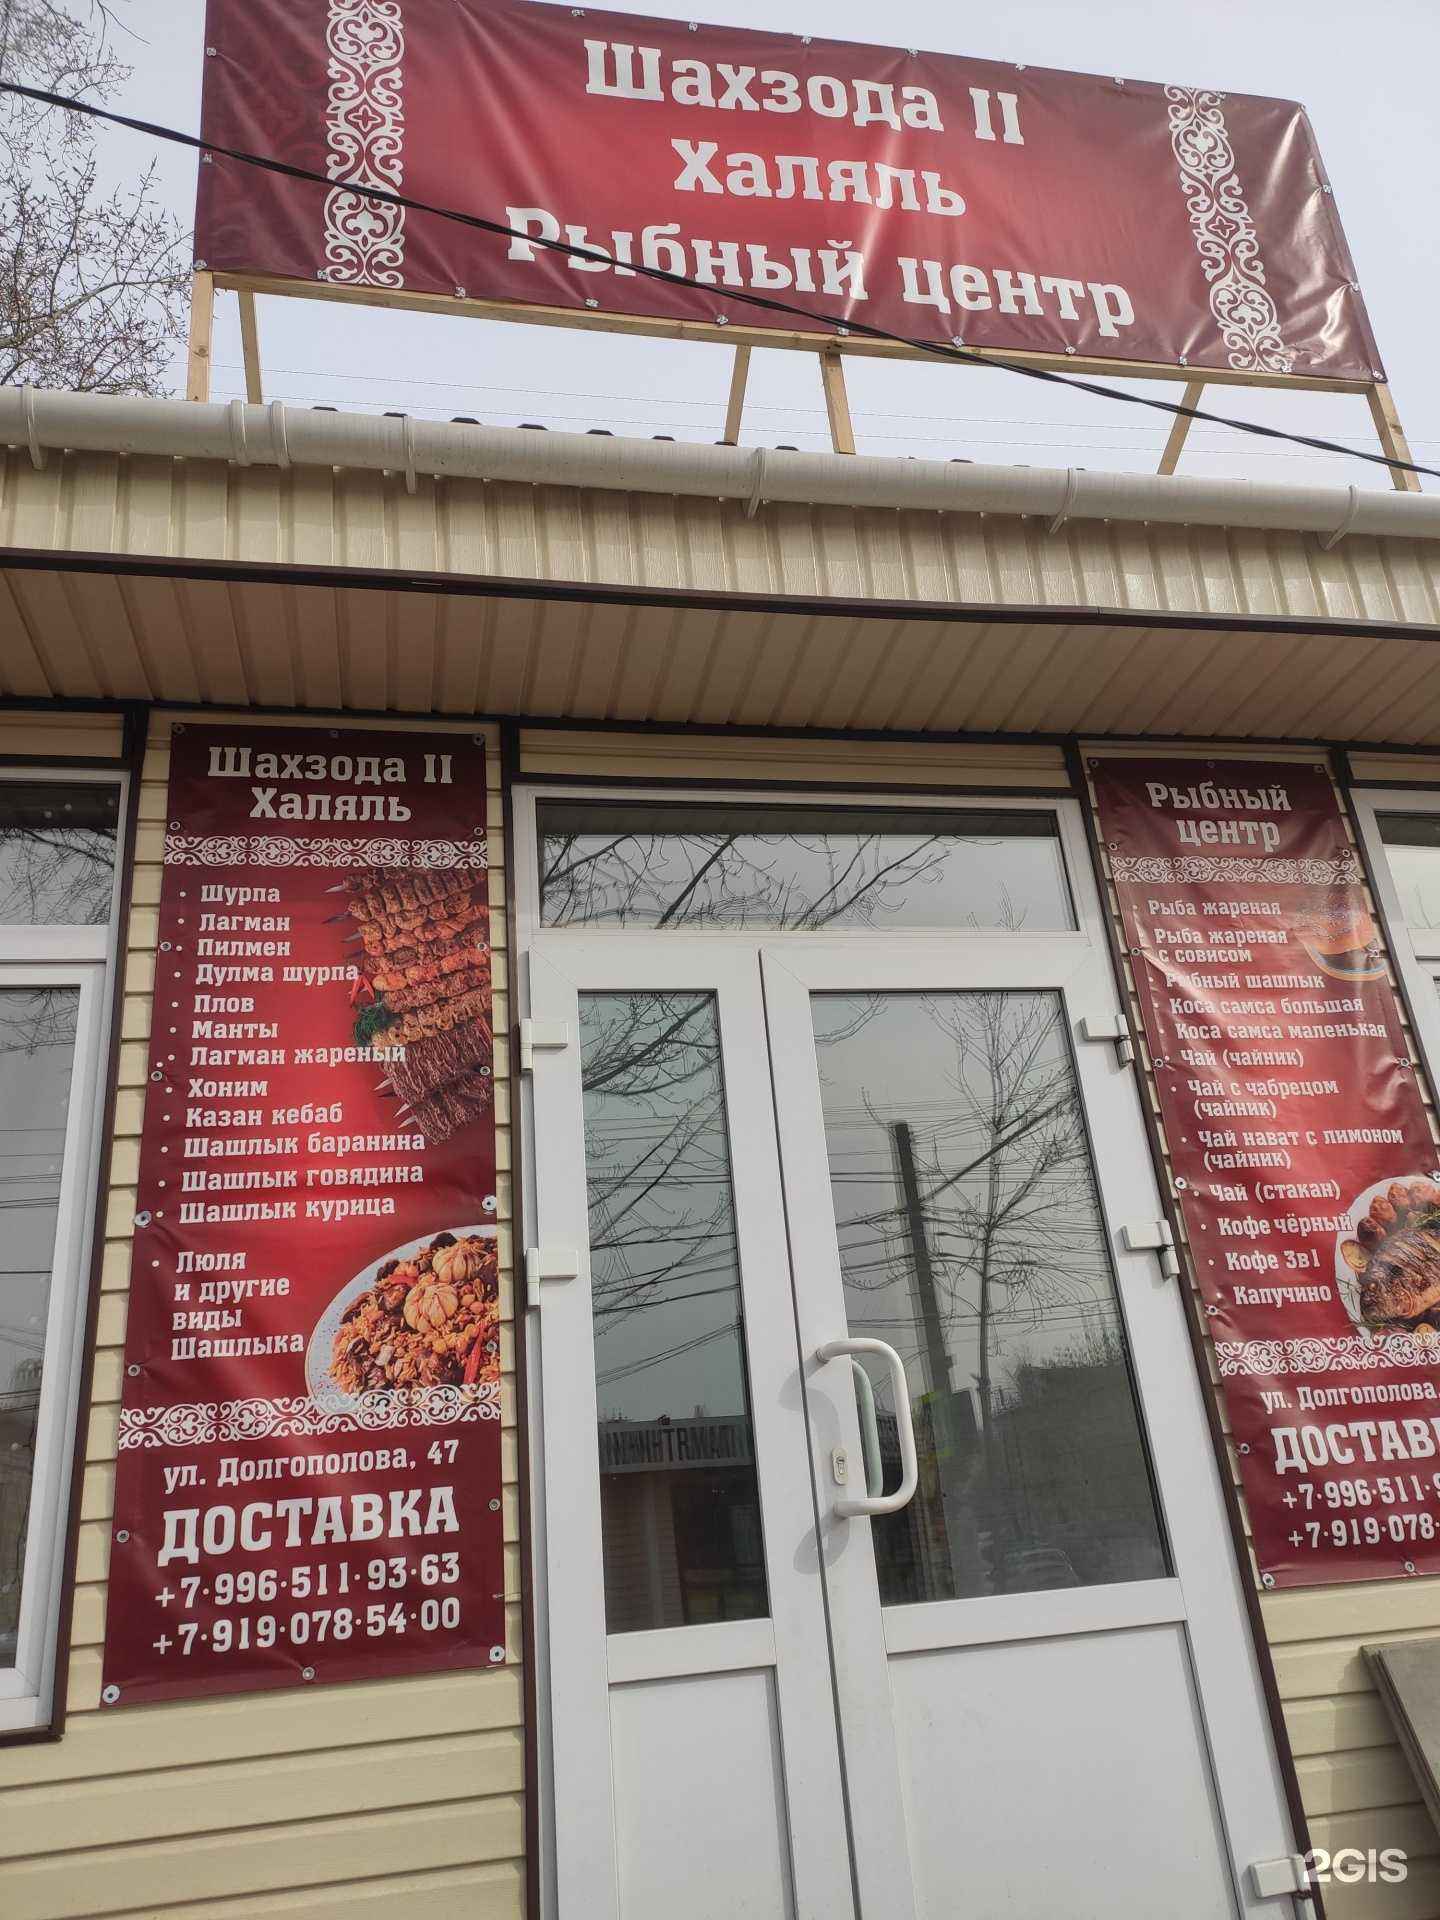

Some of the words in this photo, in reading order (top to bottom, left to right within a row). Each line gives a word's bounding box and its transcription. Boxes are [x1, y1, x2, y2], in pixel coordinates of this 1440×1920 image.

[584, 39, 943, 131] Шахзода
[672, 138, 966, 216] Халяль
[506, 205, 869, 301] Рыбный
[898, 255, 1135, 338] центр
[207, 747, 406, 785] Шахзода
[250, 787, 411, 822] Халяль
[1145, 782, 1292, 811] Рыбный
[1176, 819, 1280, 852] центр
[200, 885, 280, 905] Шурпа
[1148, 900, 1196, 916] Рыба
[1203, 901, 1281, 916] жареная
[199, 914, 290, 931] Лагман
[197, 940, 290, 956] Пилмен
[1154, 928, 1204, 945] Рыба
[1208, 929, 1288, 947] жареная
[1159, 951, 1169, 961] с
[1175, 949, 1252, 962] совисом
[196, 964, 273, 985] Дулма
[283, 965, 359, 985] шурпа
[1245, 974, 1326, 988] шашлык
[194, 994, 254, 1012] Плов
[1169, 999, 1216, 1014] Коса
[1221, 1001, 1276, 1015] самса
[1281, 997, 1364, 1014] большая
[192, 1021, 278, 1038] Манты
[1176, 1023, 1221, 1039] Коса
[1228, 1025, 1283, 1039] самса
[1289, 1024, 1387, 1038] маленькая
[190, 1047, 285, 1066] Лагман
[294, 1044, 406, 1067] жареный
[1181, 1049, 1216, 1065] Чай
[1223, 1049, 1304, 1067] (чайник)
[188, 1078, 267, 1097] Хоним
[1188, 1079, 1224, 1096] Чай
[1230, 1084, 1240, 1095] с
[1246, 1079, 1339, 1099] чабрецом
[185, 1108, 262, 1127] Казан
[271, 1102, 343, 1124] кебаб
[1194, 1099, 1277, 1119] (чайник)
[183, 1136, 298, 1158] Шашлык
[307, 1132, 425, 1157] баранина
[1198, 1129, 1237, 1148] Чай
[1244, 1132, 1298, 1146] нават
[1306, 1133, 1316, 1145] с
[1323, 1129, 1404, 1144] лимоном
[1204, 1150, 1291, 1171] (чайник)
[181, 1170, 297, 1192] Шашлык
[306, 1165, 424, 1187] говядина
[1209, 1184, 1248, 1201] Чай
[1255, 1180, 1340, 1202] (стакан)
[179, 1201, 296, 1223] Шашлык
[305, 1197, 395, 1221] курица
[1217, 1217, 1271, 1239] Кофе
[1273, 1213, 1353, 1237] чёрный
[175, 1251, 246, 1273] Люля
[1225, 1251, 1279, 1273] Кофе
[1285, 1250, 1320, 1268] 3в1
[174, 1284, 190, 1301] и
[199, 1277, 290, 1304] другие
[1233, 1285, 1331, 1308] Капучино
[172, 1308, 241, 1330] виды
[171, 1333, 304, 1360] Шашлыка
[1260, 1391, 1292, 1414] ул.
[163, 1466, 205, 1493] ул.
[217, 1448, 416, 1487] Долгополова,
[427, 1439, 460, 1465] 47
[157, 1486, 460, 1567] ДОСТАВКА
